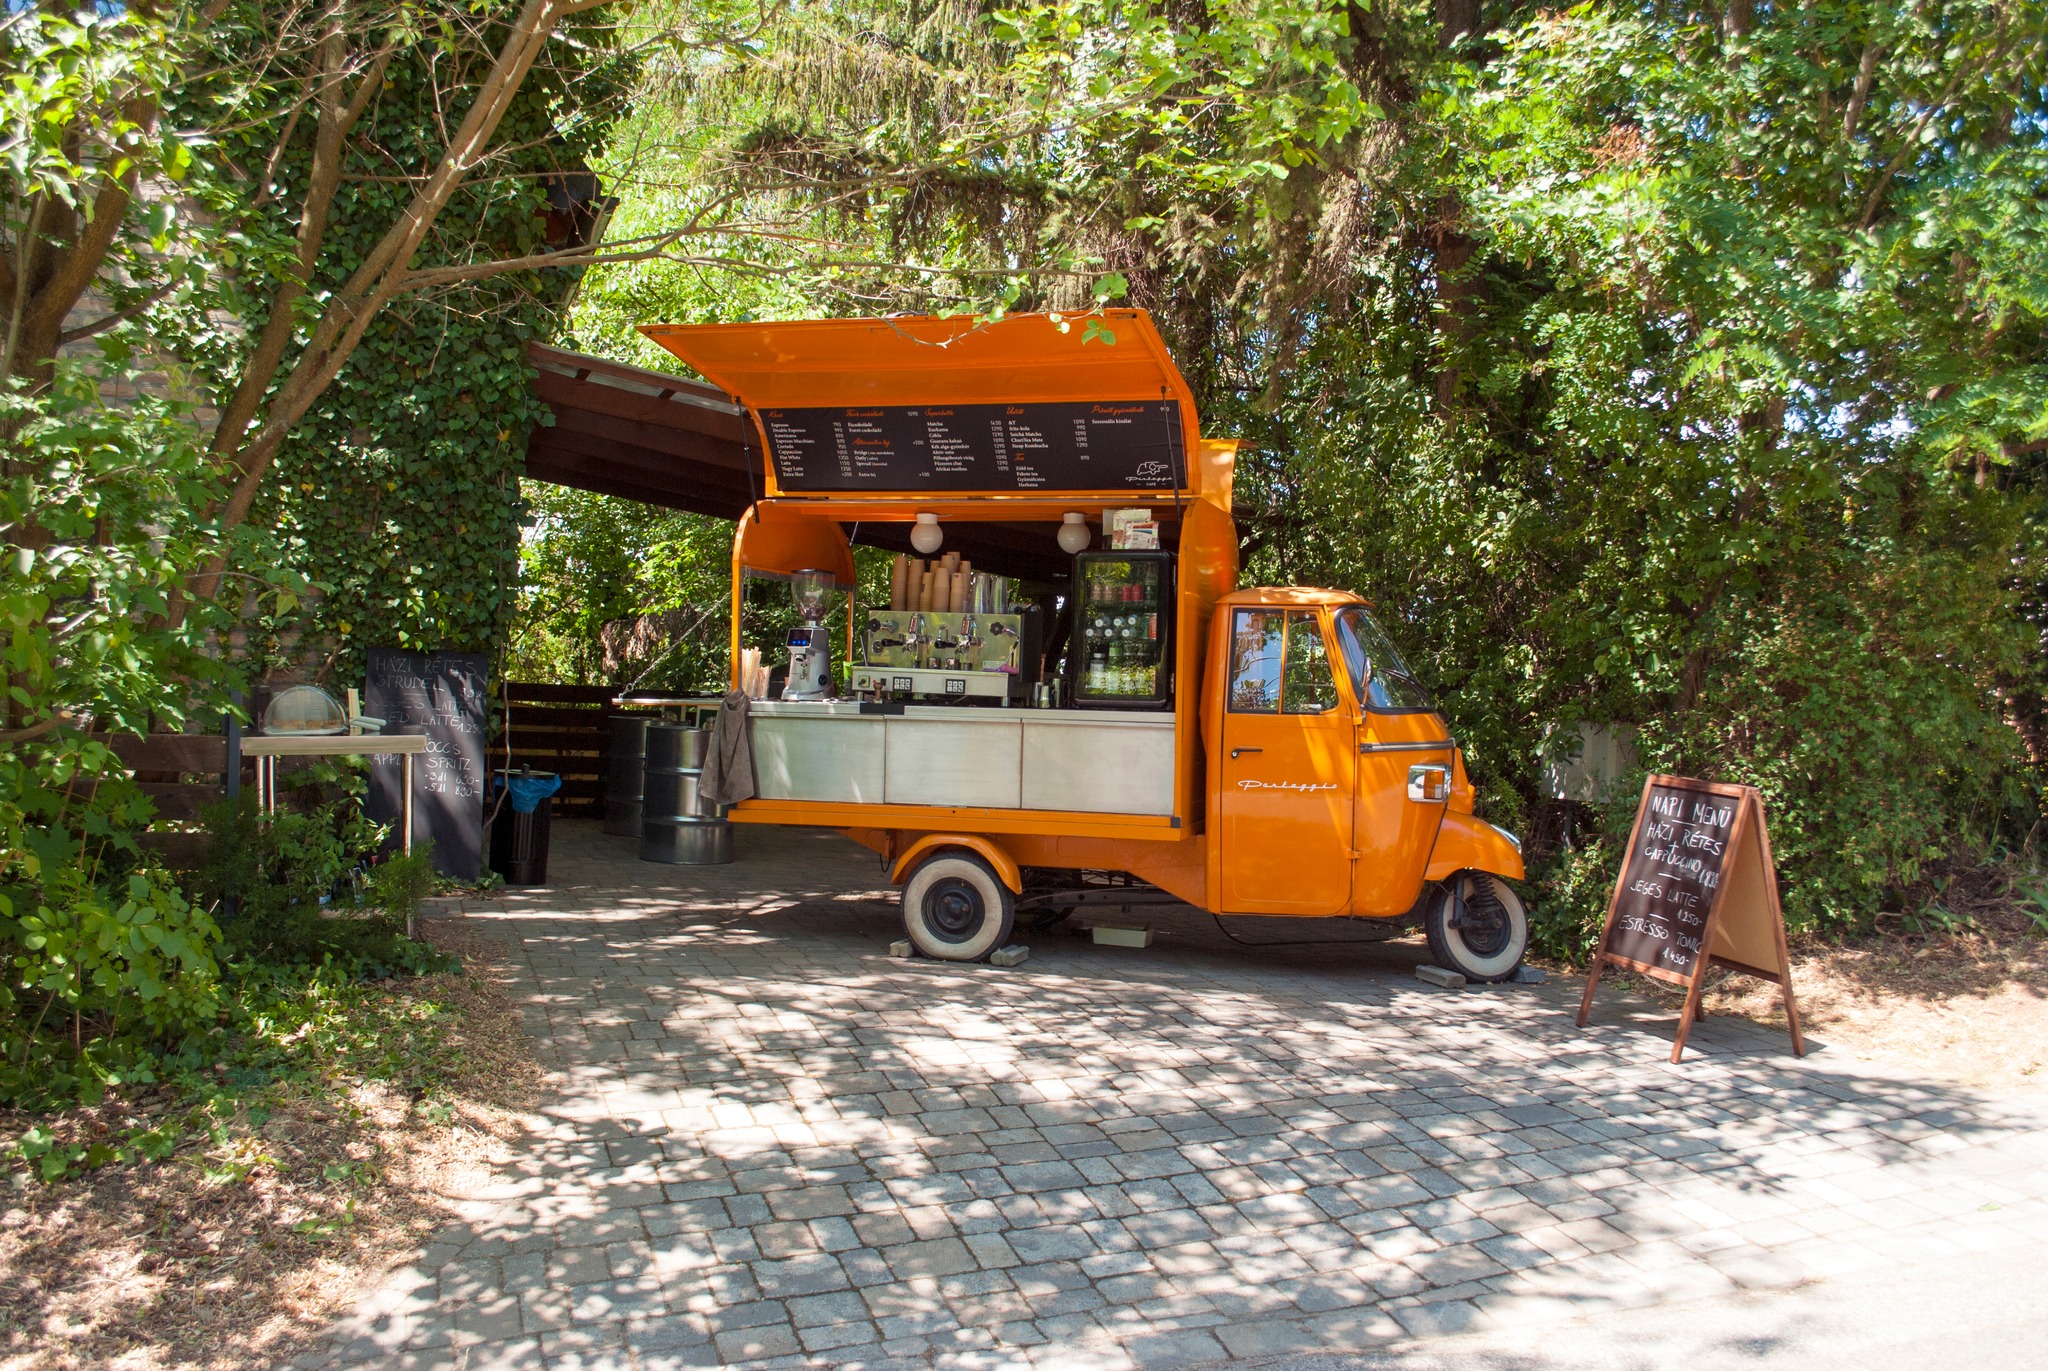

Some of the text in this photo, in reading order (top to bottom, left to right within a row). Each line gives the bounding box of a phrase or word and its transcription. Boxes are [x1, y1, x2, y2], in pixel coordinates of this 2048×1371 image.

[376, 655, 411, 673] HÁZI
[420, 714, 461, 728] LATTE
[424, 736, 462, 756] ÖCCS
[372, 753, 472, 771] APPL SPRITZ
[429, 773, 447, 782] 3dl
[1238, 780, 1338, 792] Portaggio
[429, 783, 446, 793] 5dl
[1652, 795, 1732, 828] NAPI MENÜ
[1646, 820, 1724, 856] HÁZI RÉTES
[1644, 846, 1702, 872] CAPPUCCINO
[1630, 880, 1700, 908] JEGES LATTE
[1618, 914, 1703, 954] ESPRESSO TONIC
